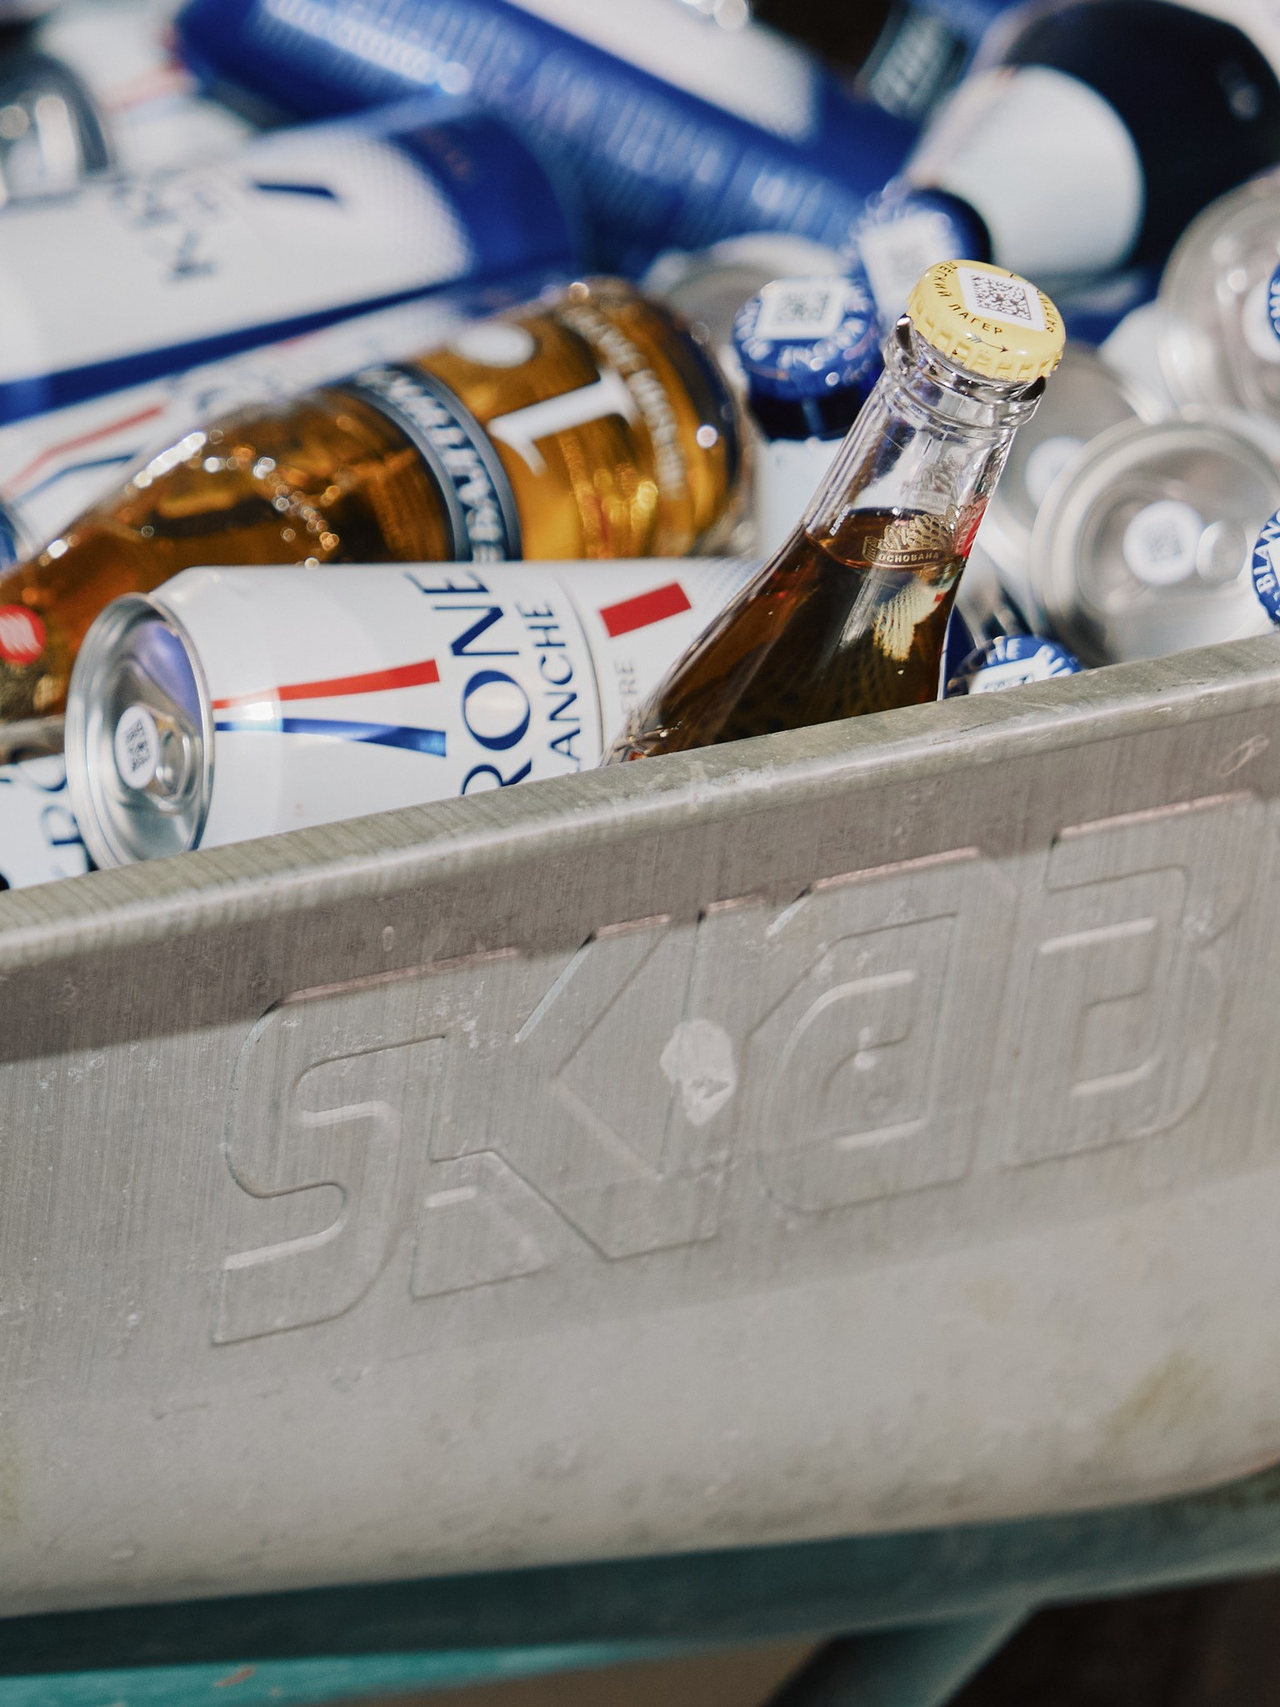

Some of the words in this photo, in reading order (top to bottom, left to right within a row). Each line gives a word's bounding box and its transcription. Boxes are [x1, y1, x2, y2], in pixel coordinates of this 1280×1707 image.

[948, 302, 1003, 335] ЛАГЕР
[878, 550, 940, 564] ОСНОВАНА
[1253, 508, 1280, 595] BLAN
[402, 570, 532, 795] RONE
[515, 600, 581, 773] ANCHE
